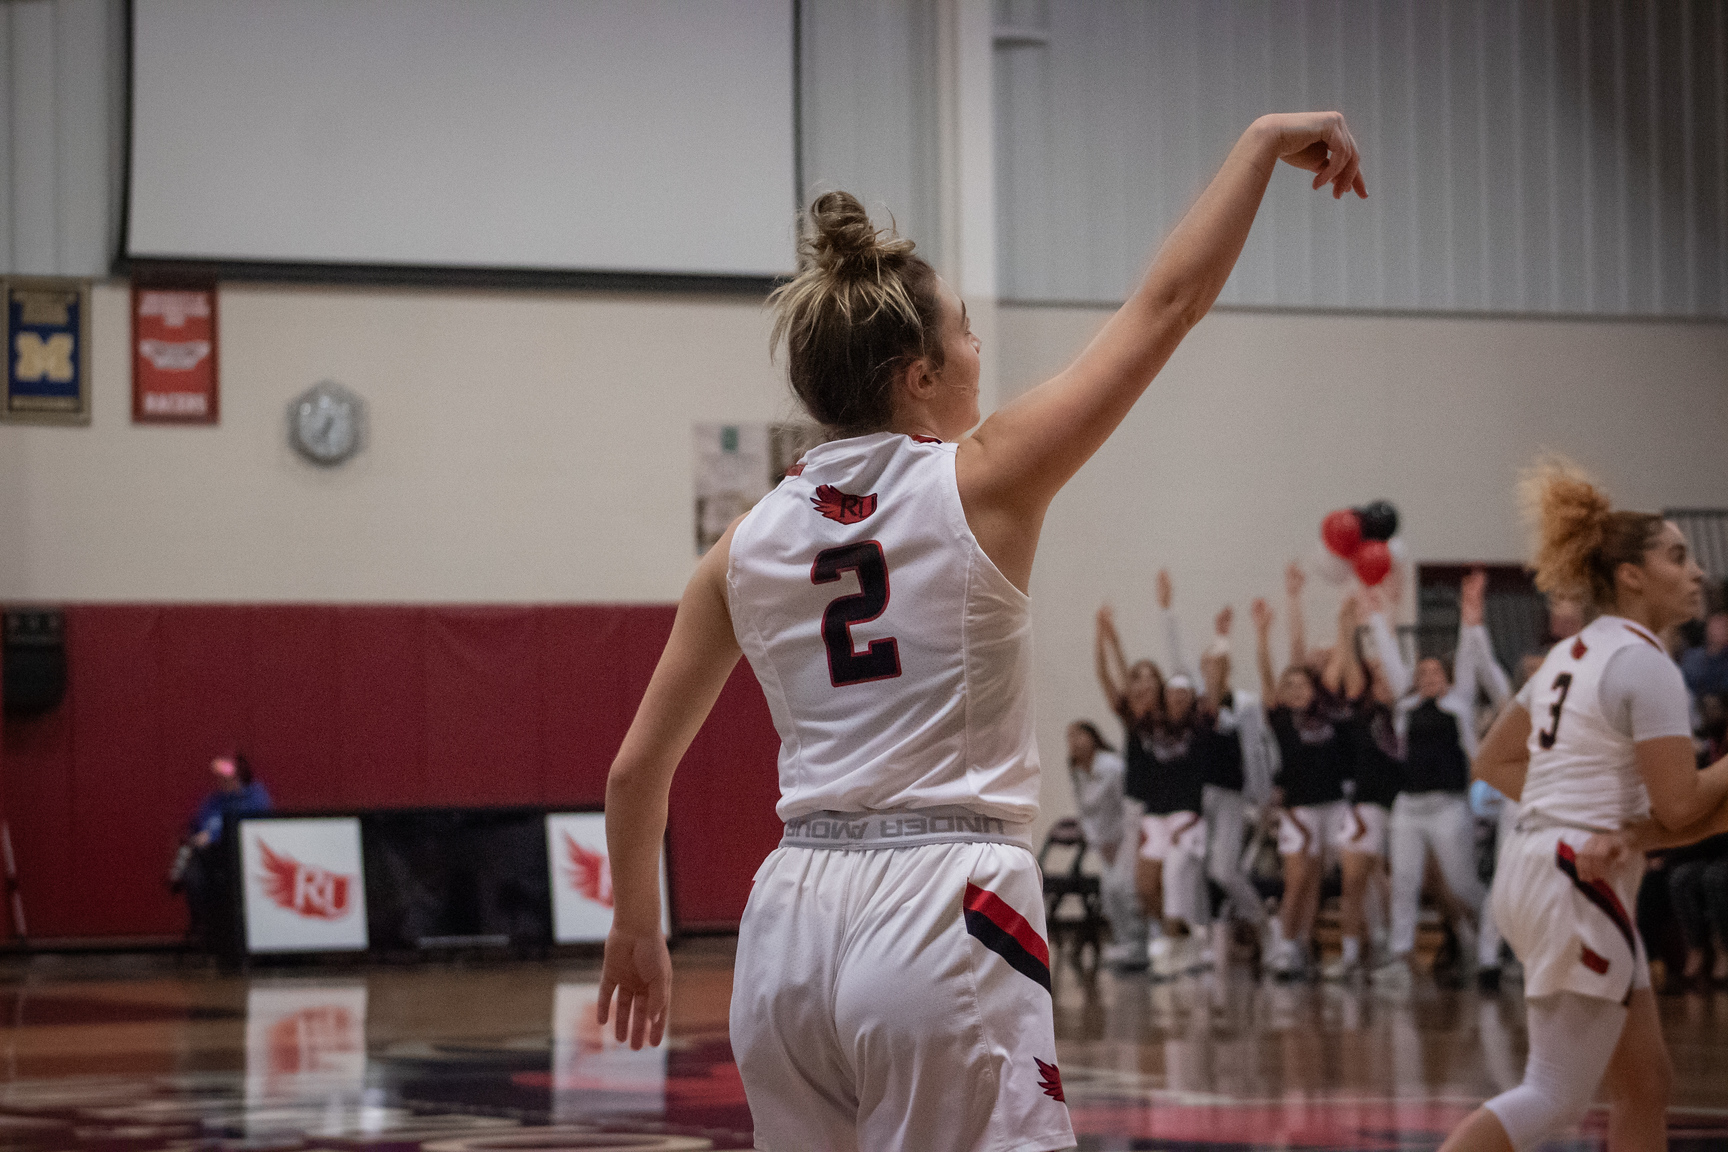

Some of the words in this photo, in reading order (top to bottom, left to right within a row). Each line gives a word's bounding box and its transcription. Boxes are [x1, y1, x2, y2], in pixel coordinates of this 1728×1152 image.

[810, 540, 902, 687] 2
[1539, 670, 1573, 751] 3
[880, 815, 1004, 838] UNDER
